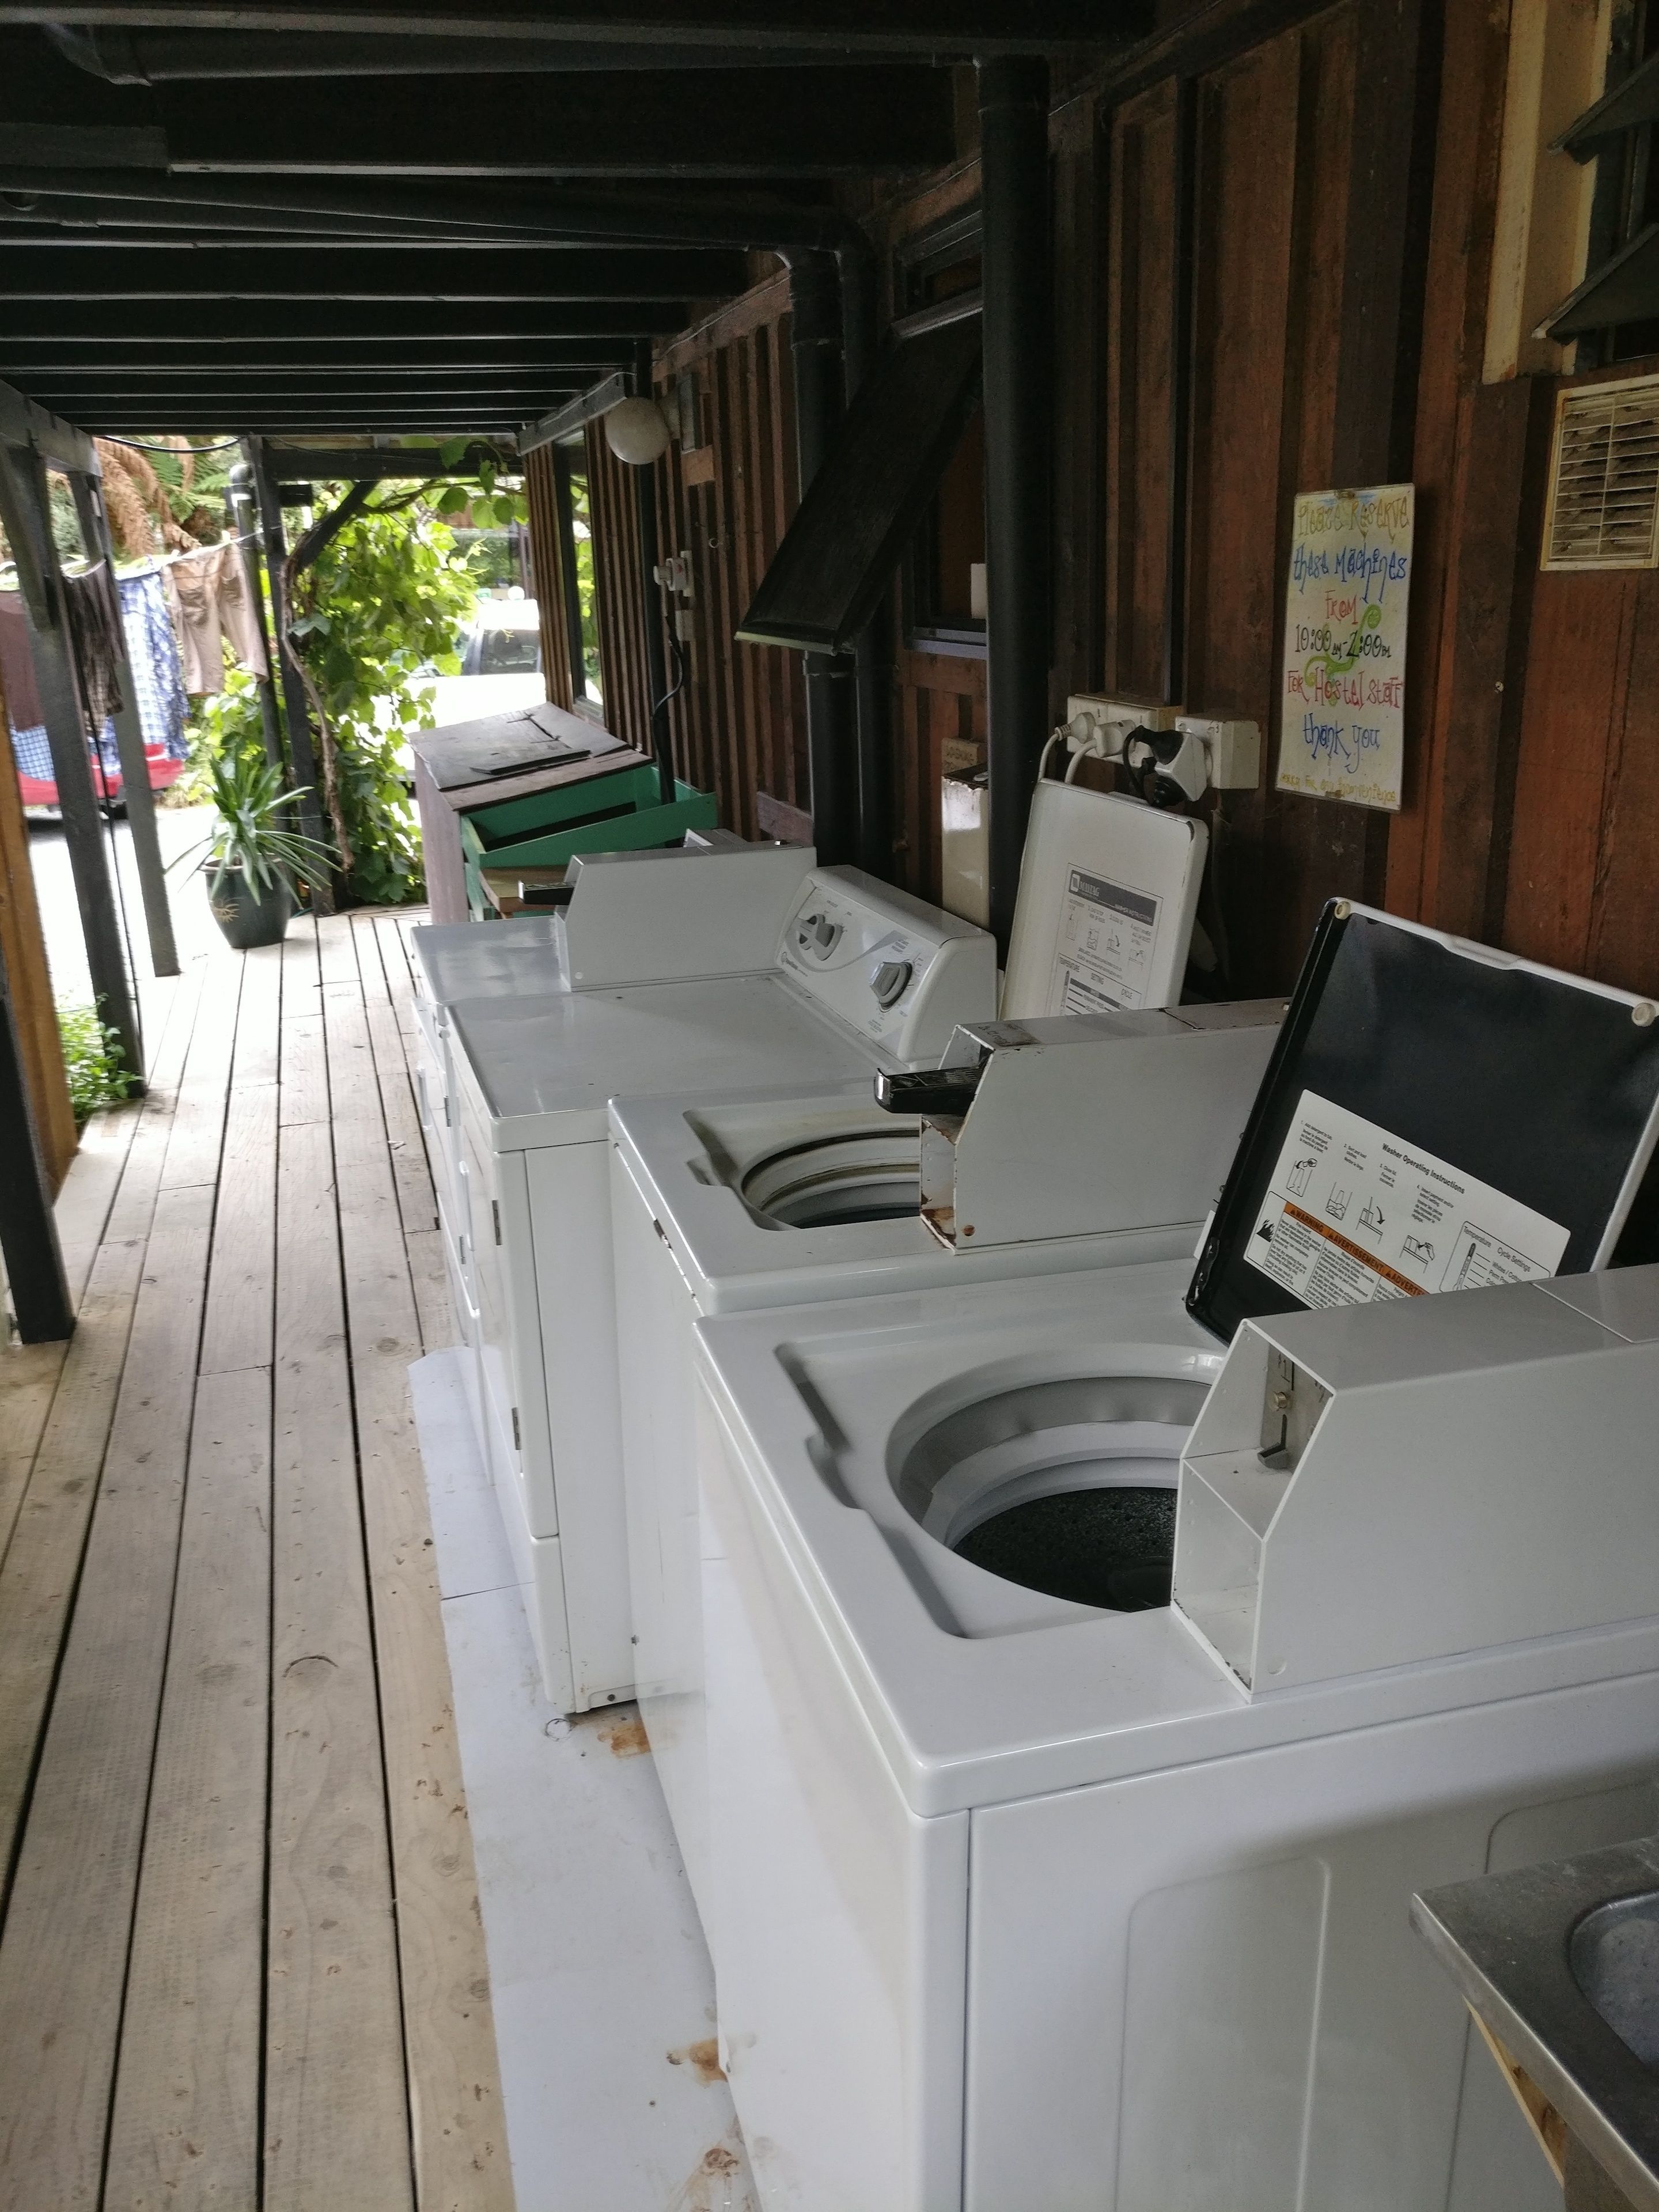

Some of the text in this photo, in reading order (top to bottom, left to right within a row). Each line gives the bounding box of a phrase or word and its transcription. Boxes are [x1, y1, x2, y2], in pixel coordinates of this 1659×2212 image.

[1382, 1143, 1464, 1194] Washer Operating Instructions
[1296, 1210, 1323, 1232] WARNING
[1334, 1235, 1383, 1271] AVERTISSEMENT
